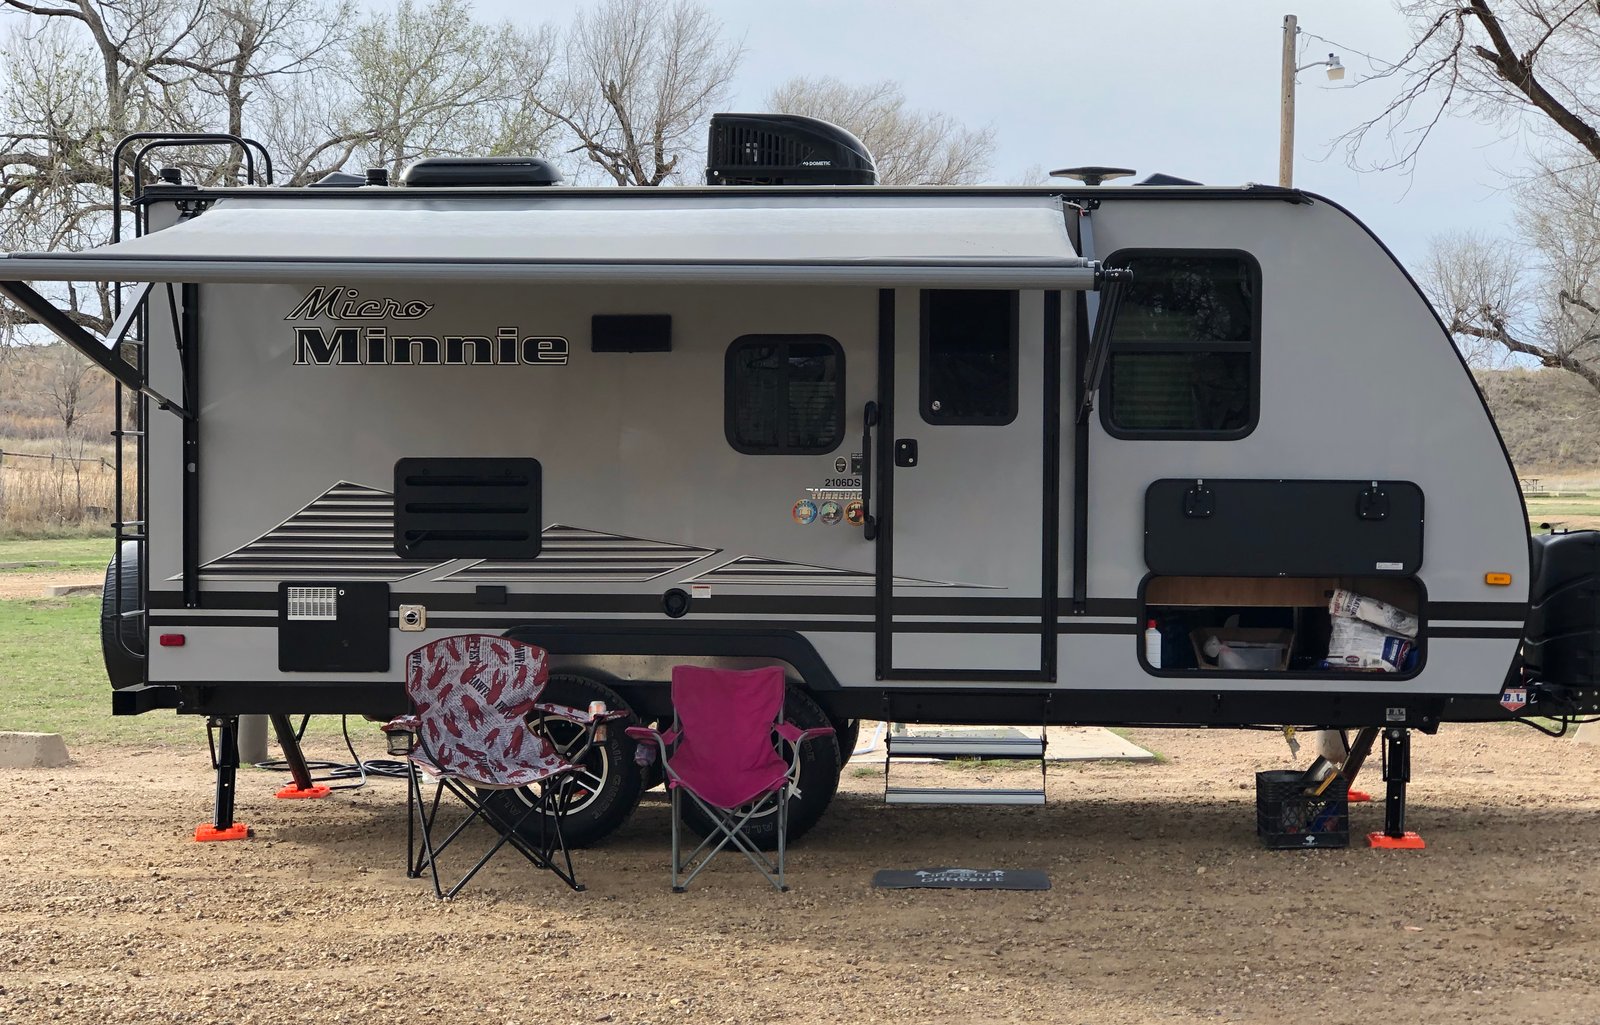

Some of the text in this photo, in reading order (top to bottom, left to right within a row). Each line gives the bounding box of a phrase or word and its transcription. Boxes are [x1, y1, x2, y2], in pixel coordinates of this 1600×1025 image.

[284, 286, 435, 320] Micro
[293, 327, 569, 365] Minnie
[825, 478, 861, 487] 2106DS
[811, 490, 863, 500] WINNEBAG
